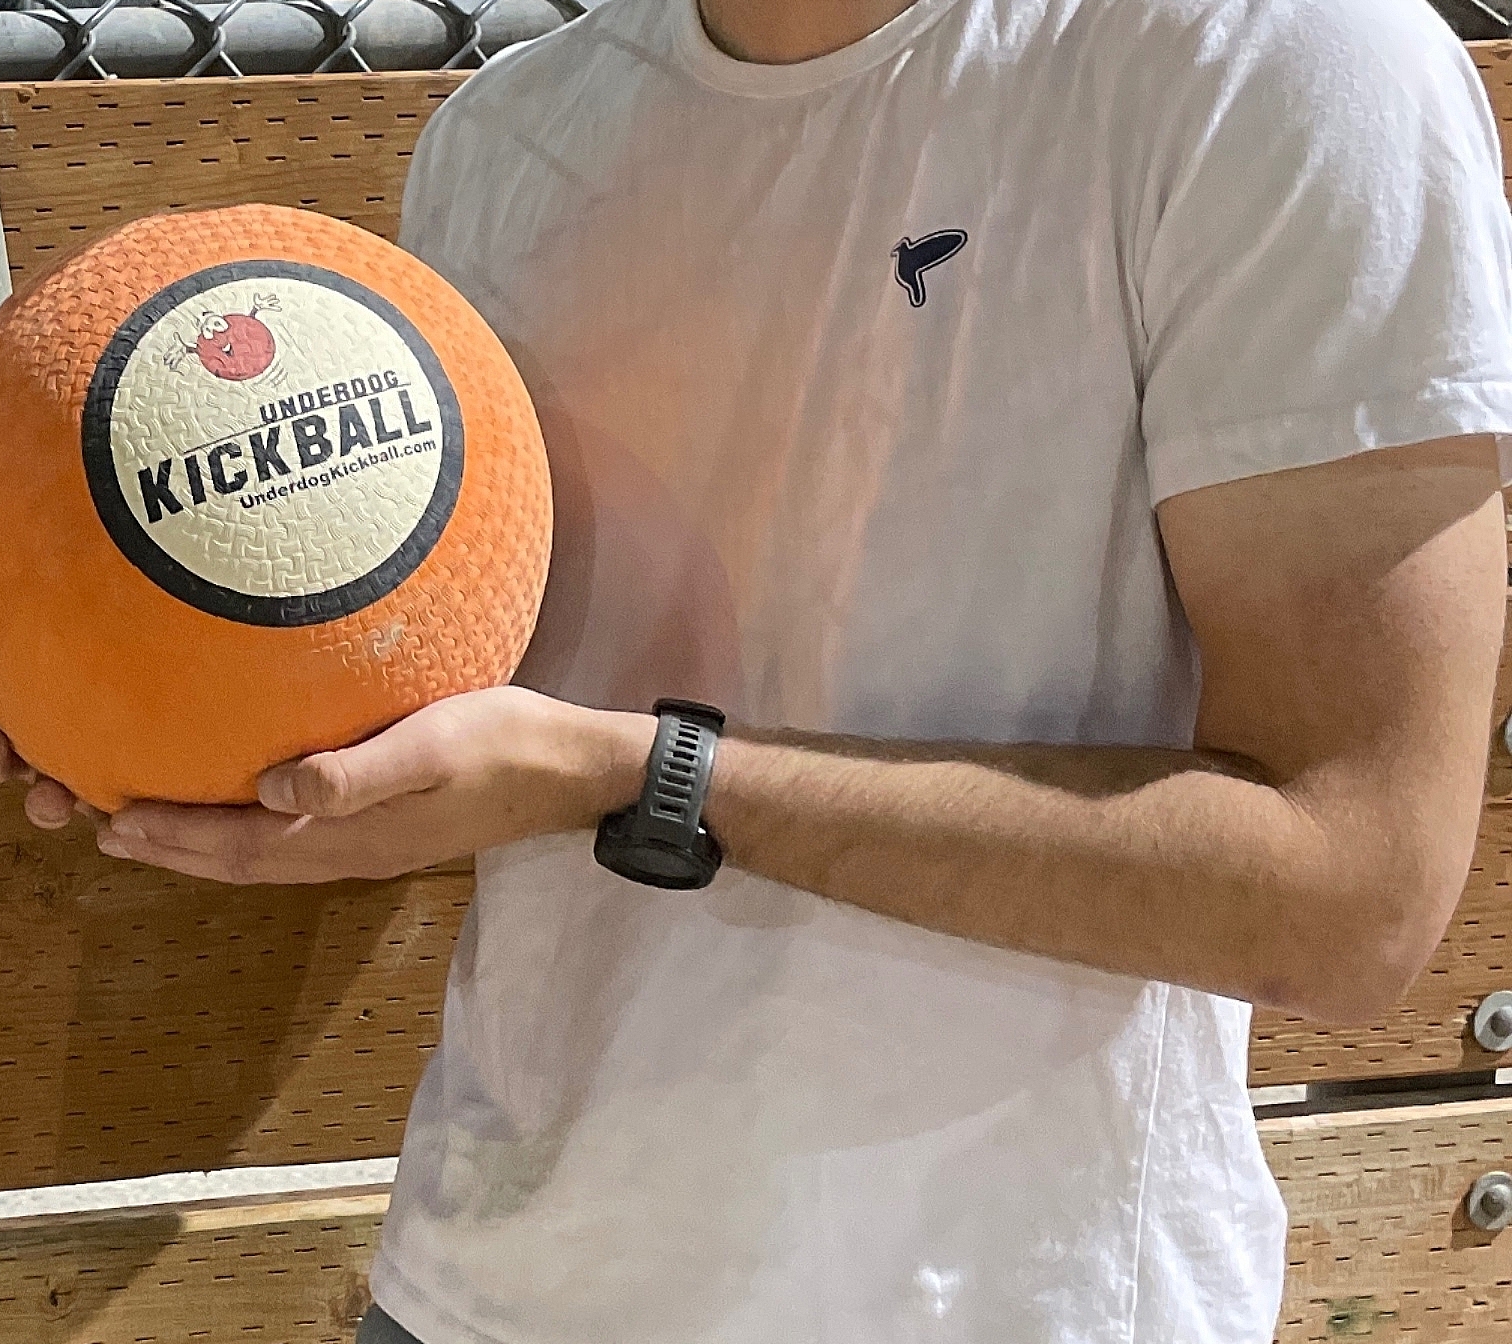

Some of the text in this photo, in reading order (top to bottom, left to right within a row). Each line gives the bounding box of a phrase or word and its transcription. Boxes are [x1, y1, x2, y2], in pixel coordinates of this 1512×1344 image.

[259, 370, 400, 424] UNDERDOG
[137, 390, 433, 524] KICKBALL
[239, 439, 437, 510] UnderdogKickball.com
